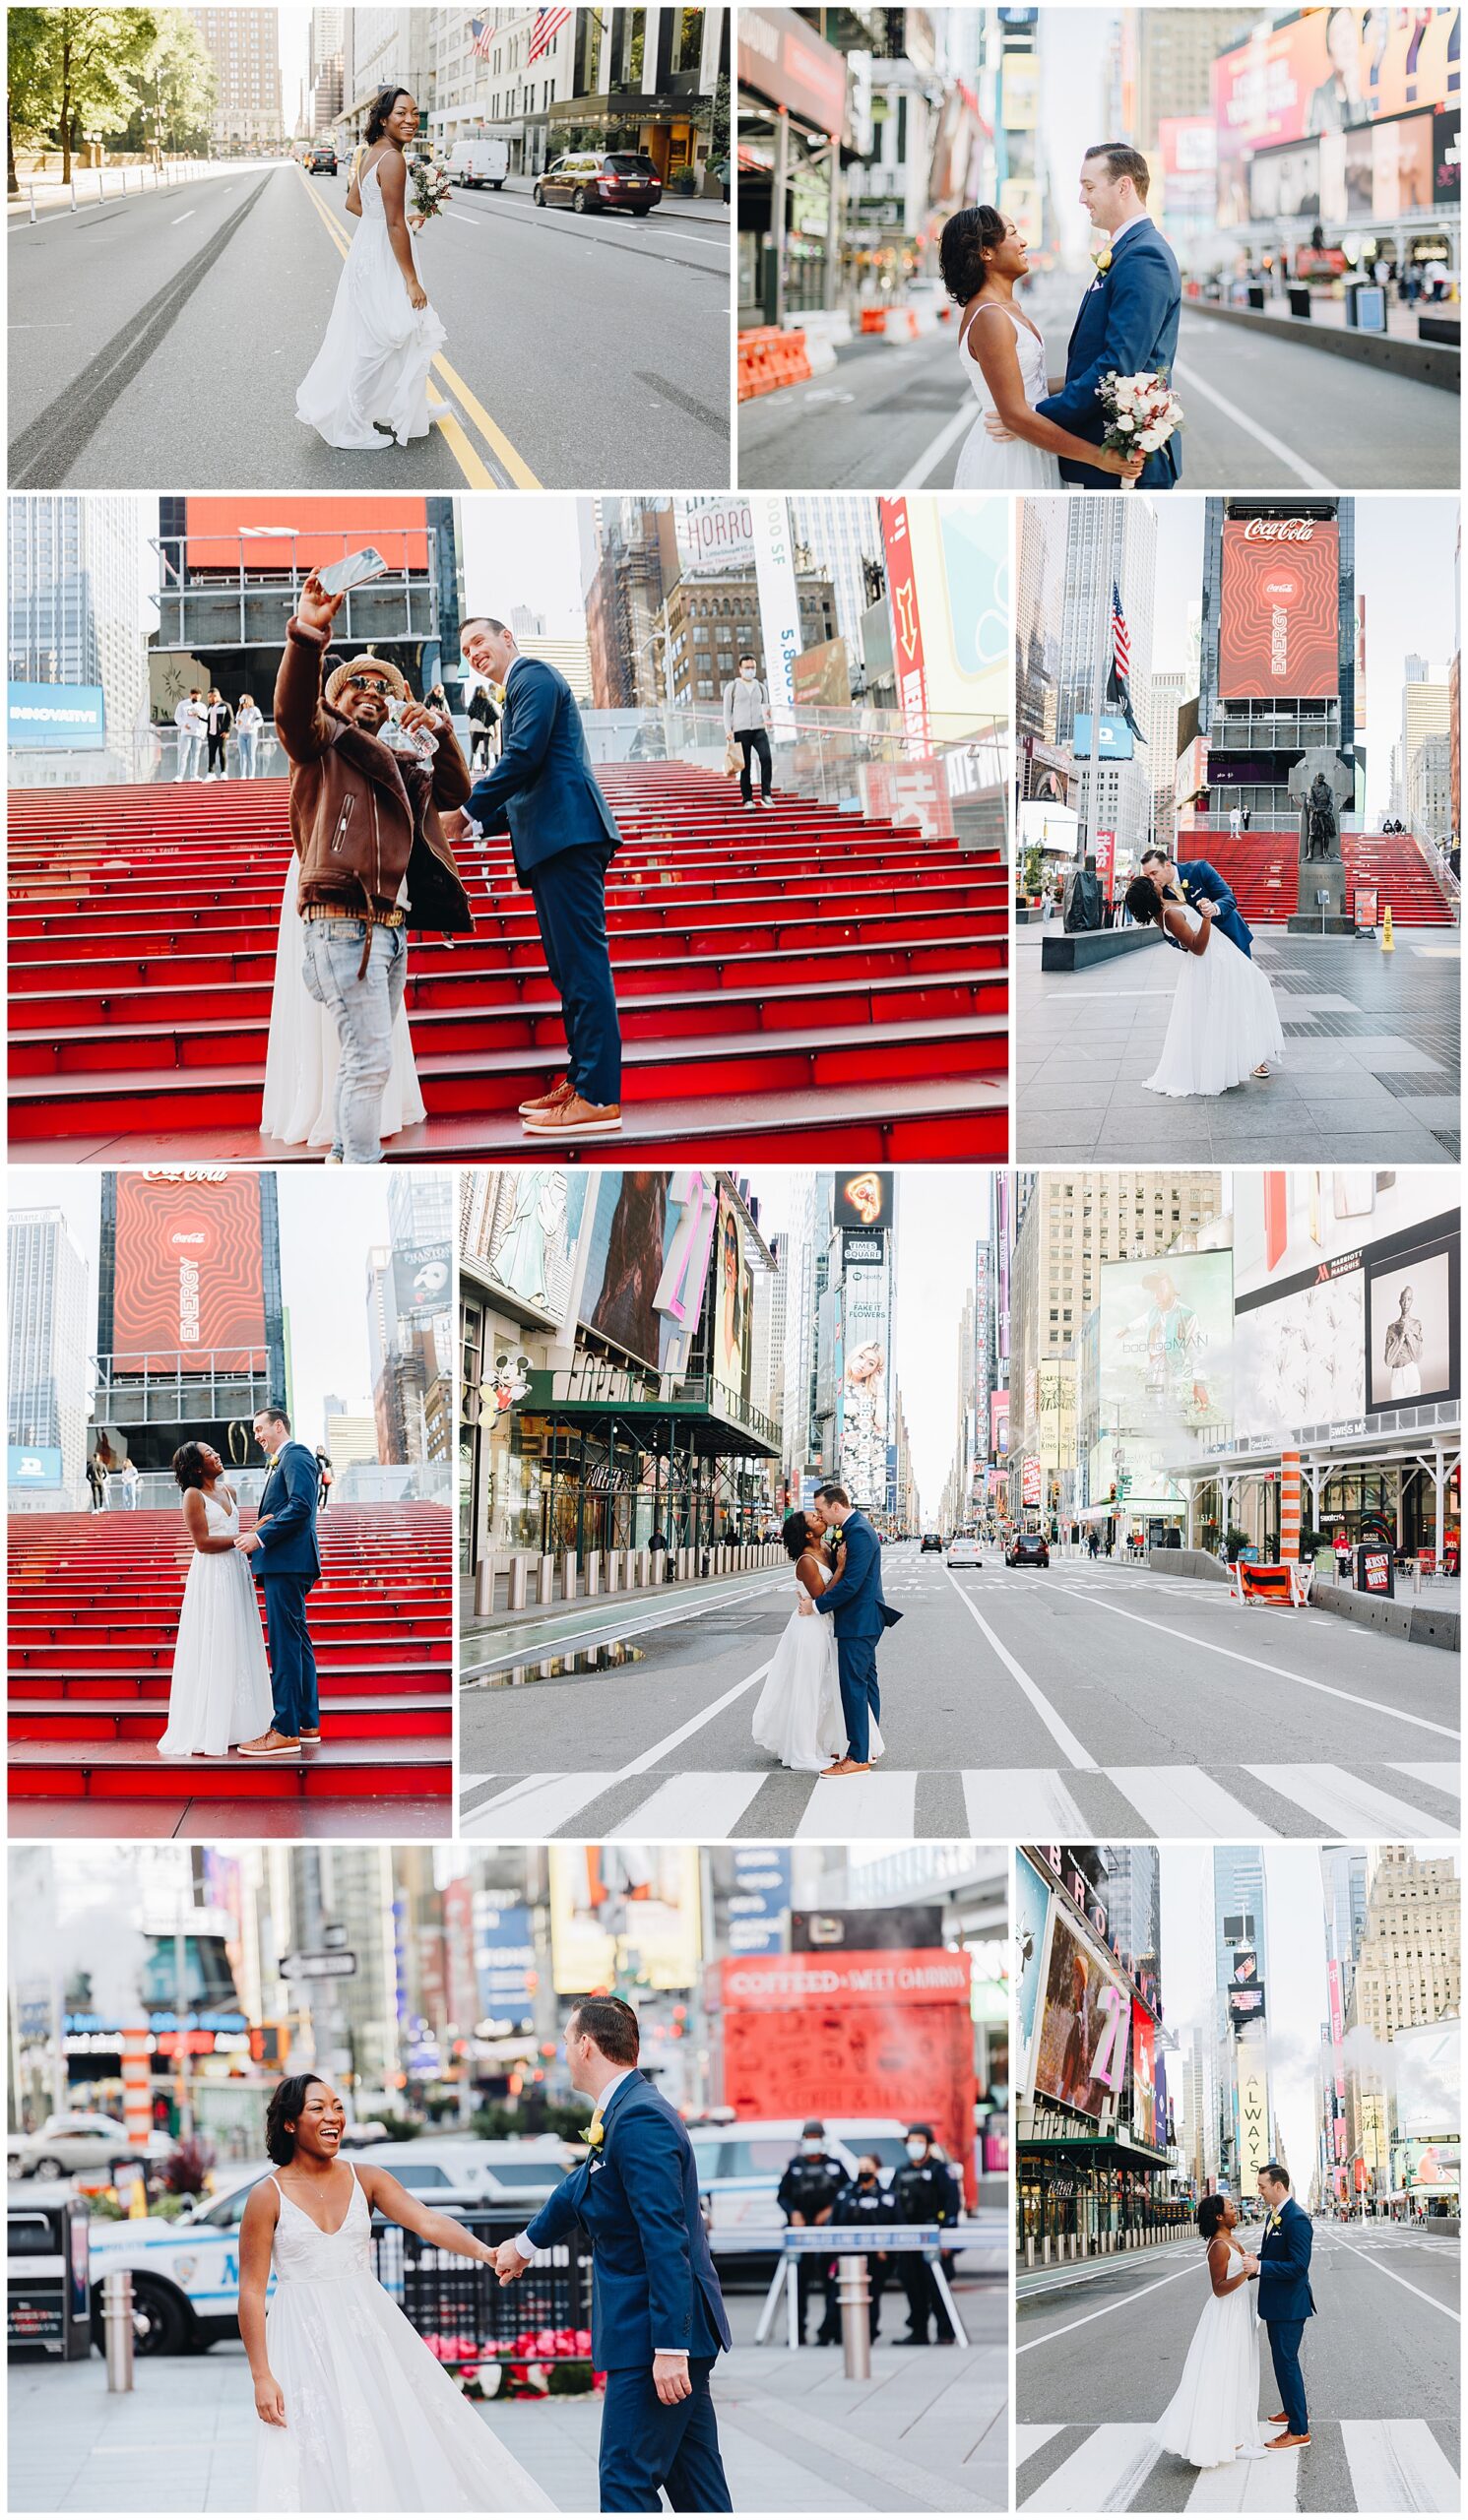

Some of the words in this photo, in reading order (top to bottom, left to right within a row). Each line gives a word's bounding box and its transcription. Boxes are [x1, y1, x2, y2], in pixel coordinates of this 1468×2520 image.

[1245, 517, 1317, 540] Coca-Cola
[1271, 604, 1288, 674] ENERGY
[10, 707, 96, 724] INNOVATIVE
[845, 1250, 881, 1259] SQUARE
[862, 1273, 882, 1282] Spotify
[179, 1256, 199, 1342] ENERGY
[1365, 1553, 1388, 1569] JERSEY
[1367, 1570, 1388, 1586] BOYS
[1245, 2074, 1261, 2173] ALWAYS
